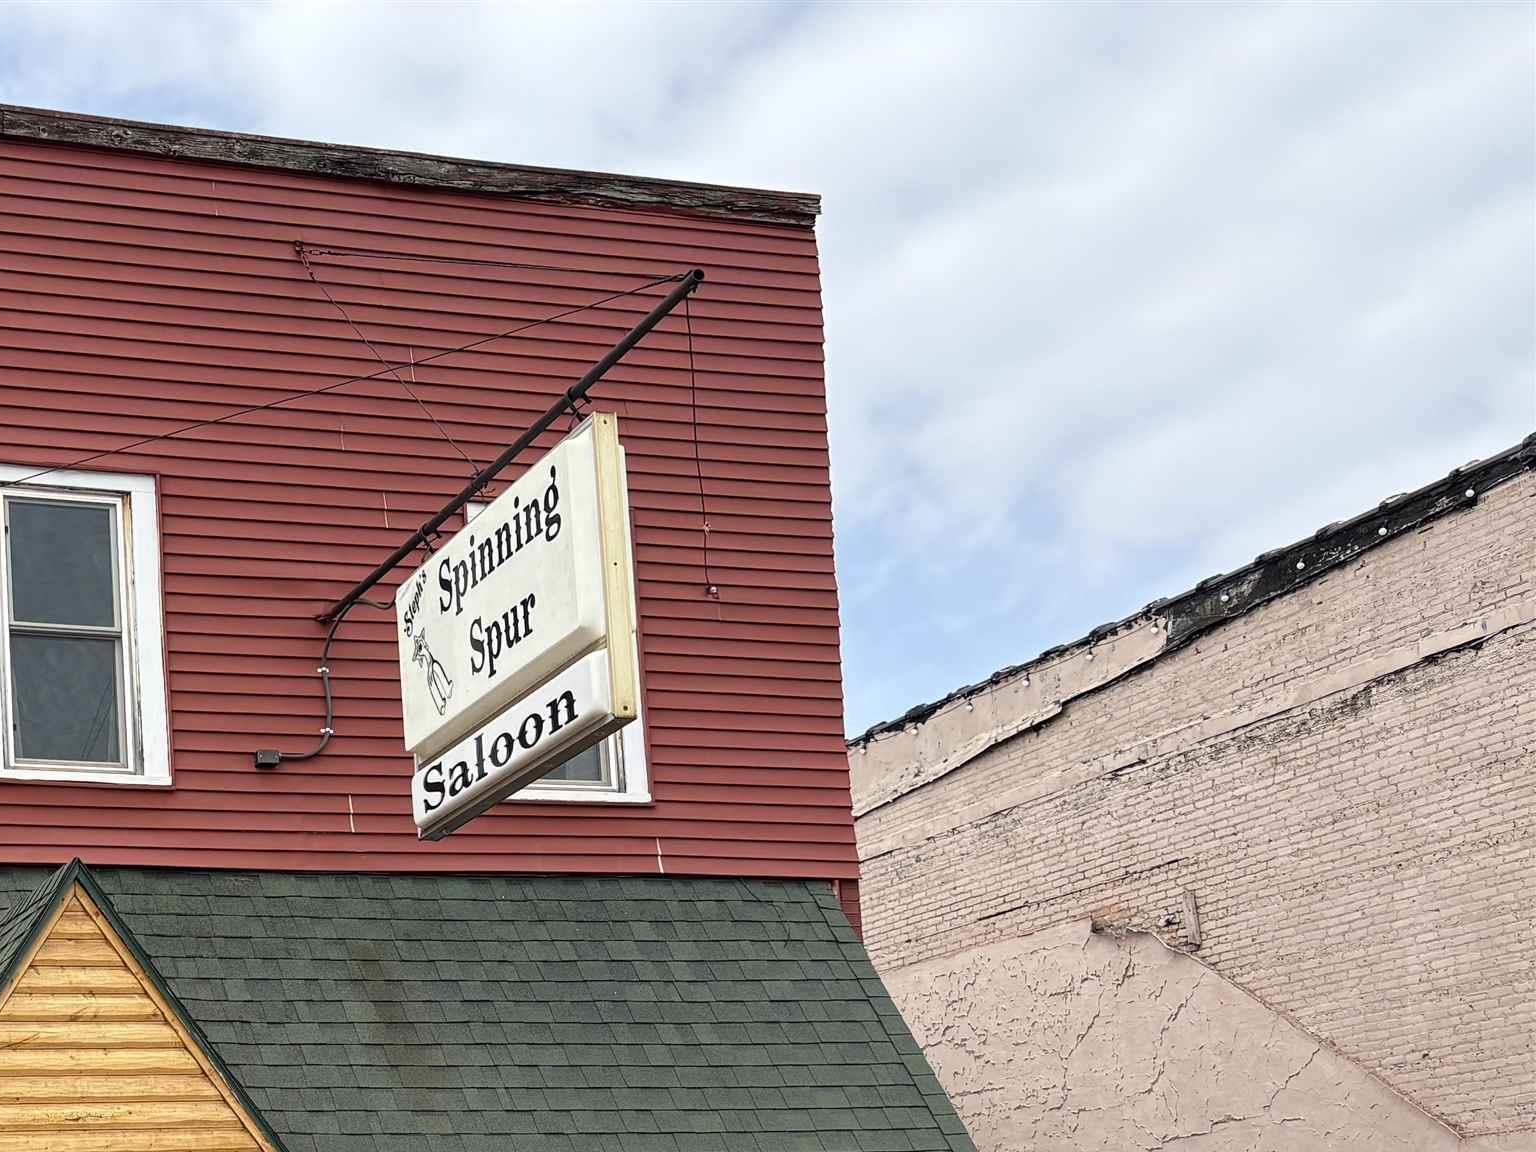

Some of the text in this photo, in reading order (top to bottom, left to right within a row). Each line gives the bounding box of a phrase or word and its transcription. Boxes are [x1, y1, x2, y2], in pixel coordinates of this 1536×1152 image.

[439, 465, 562, 616] Spinning
[403, 567, 428, 638] Steph's
[470, 593, 537, 679] Spur
[423, 687, 579, 813] Saloon
